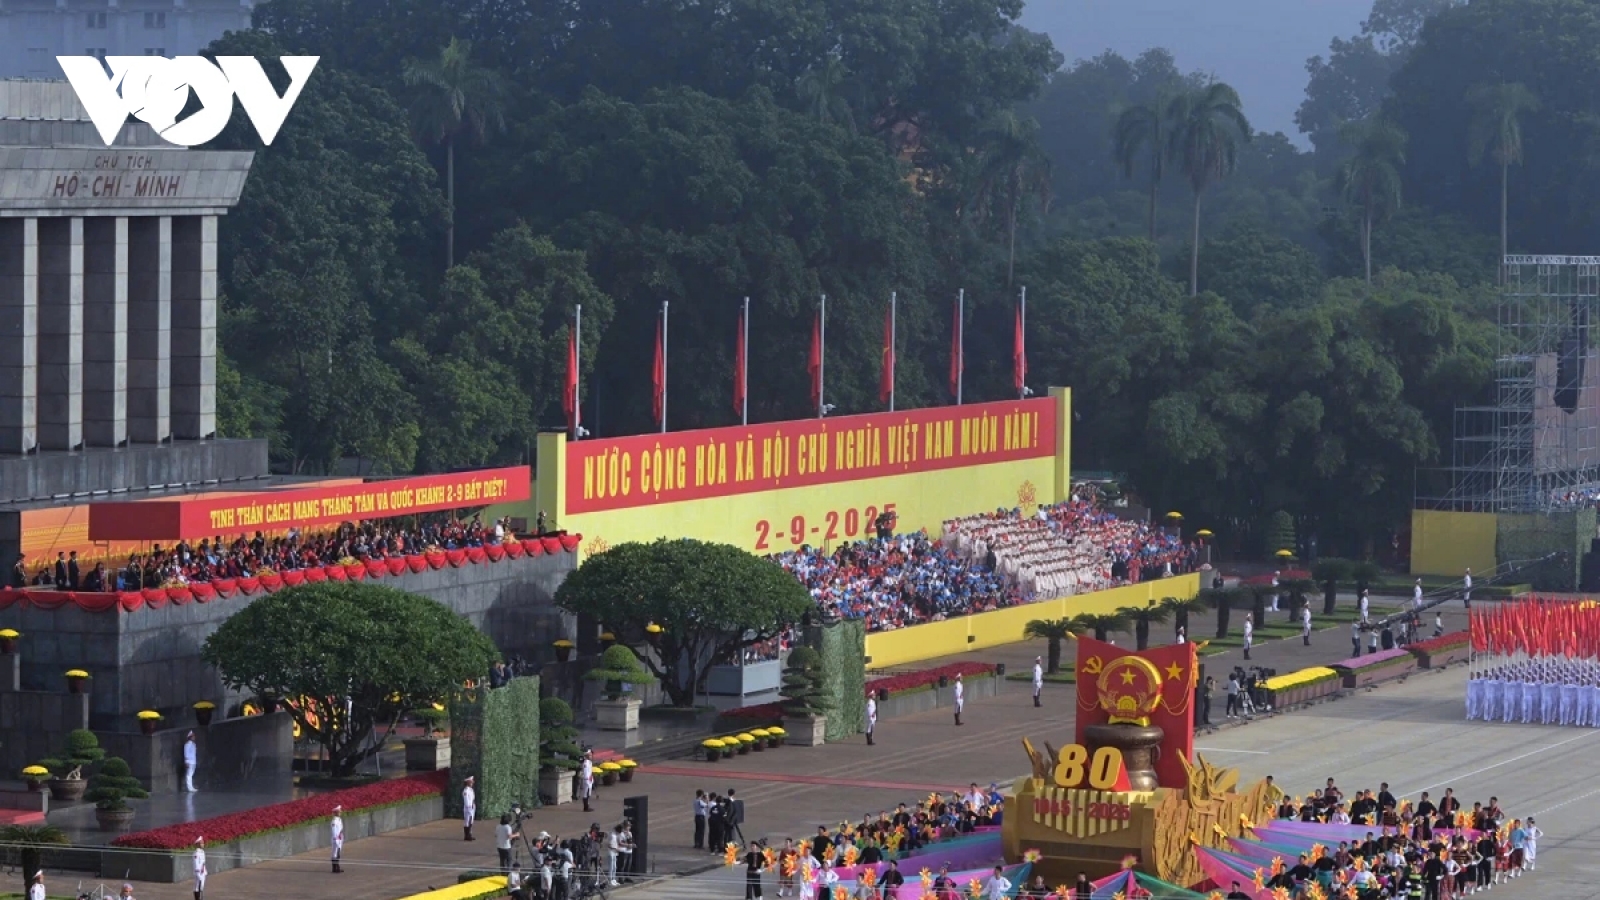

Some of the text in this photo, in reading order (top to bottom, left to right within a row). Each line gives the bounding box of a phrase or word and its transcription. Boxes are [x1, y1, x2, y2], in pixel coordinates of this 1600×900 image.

[584, 446, 631, 500] NƯỚC
[641, 441, 686, 500] CỘNG
[695, 437, 727, 487] HÒA
[735, 433, 754, 482] XÃ
[763, 430, 790, 485] HỘI
[798, 423, 828, 475] CHỦ
[836, 423, 881, 470] NGHĨA
[888, 418, 919, 470] VIỆT
[925, 420, 954, 460] NAM
[961, 410, 998, 456] MUÔN
[210, 508, 235, 529] TINH
[237, 499, 264, 526] THẦN
[266, 500, 291, 522] CÁCH
[293, 499, 320, 523] MẠNG
[322, 493, 353, 517] THÁNG
[355, 490, 375, 513] TÁM
[377, 488, 389, 511] VÀ
[390, 484, 413, 510] QUỐC
[415, 483, 446, 506] KHÁNH
[464, 476, 483, 501] BẤT
[1054, 743, 1124, 790] 80
[1088, 803, 1130, 821] 2025
